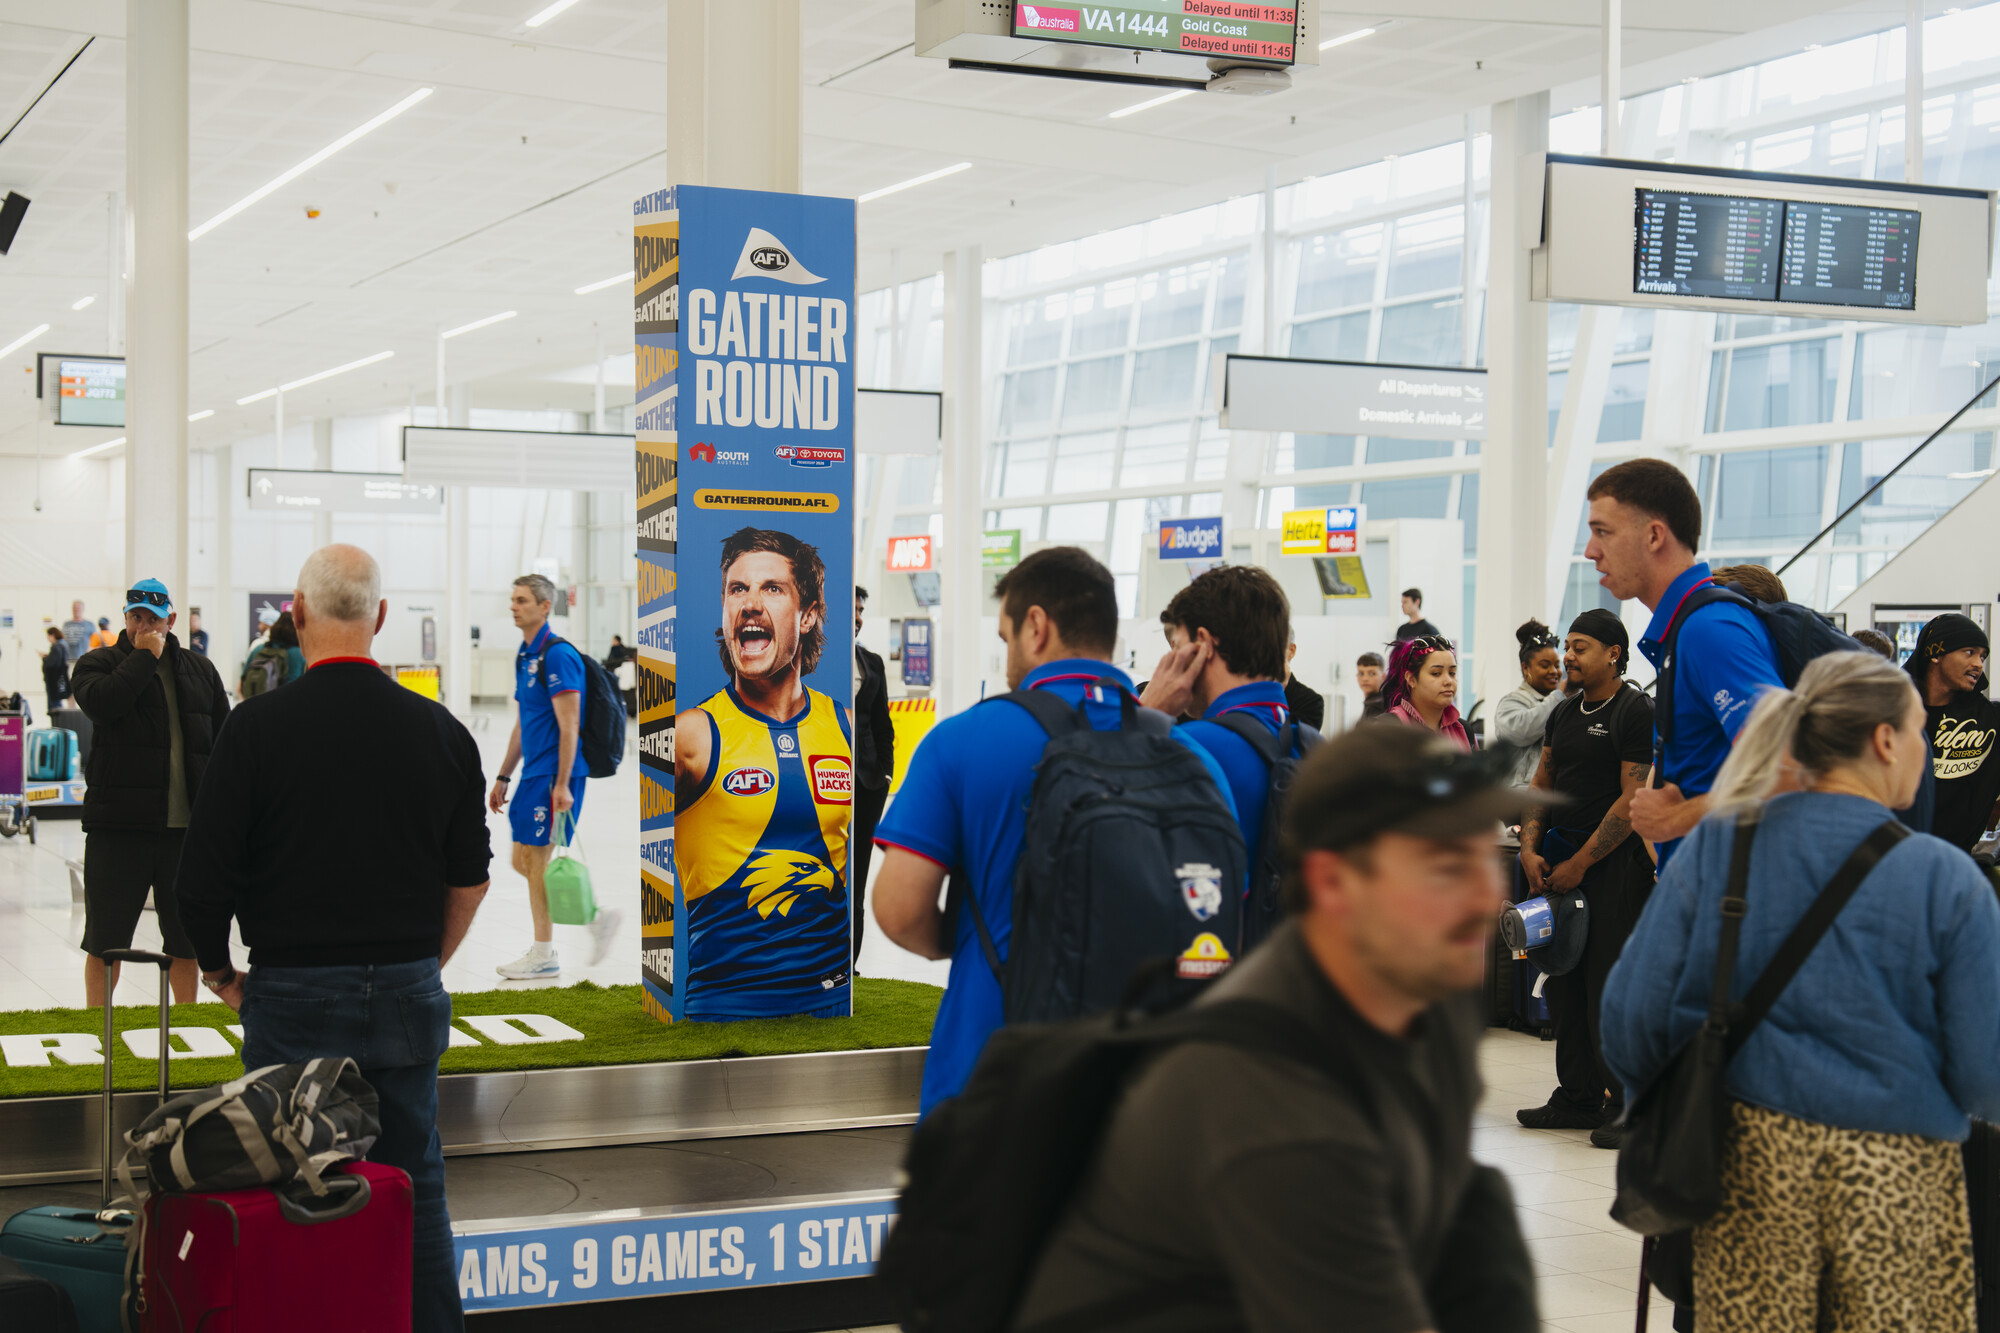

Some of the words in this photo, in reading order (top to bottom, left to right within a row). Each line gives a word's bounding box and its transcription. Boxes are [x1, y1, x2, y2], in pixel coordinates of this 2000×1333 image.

[1039, 17, 1074, 30] australia
[1082, 7, 1169, 38] VA1444
[1182, 19, 1210, 33] Gold
[1213, 22, 1248, 36] Coast
[1184, 1, 1232, 18] Delayed
[1234, 5, 1260, 19] until
[1263, 9, 1294, 23] 11:35
[1181, 35, 1230, 53] Delayed
[1232, 40, 1258, 55] until
[1260, 44, 1291, 58] 11:45
[634, 235, 678, 285] ROUND
[753, 249, 787, 267] AFL
[1638, 278, 1677, 293] Arrivals
[635, 284, 679, 323] GATHER
[688, 288, 848, 363] GATHER
[635, 343, 679, 394] ROUND
[695, 359, 840, 430] ROUND
[1379, 379, 1396, 394] All
[1398, 380, 1462, 398] Departures
[635, 396, 678, 431] GATHER
[1359, 407, 1415, 424] Domestic
[1416, 411, 1462, 426] Arrivals
[717, 451, 749, 462] SOUTH
[776, 447, 796, 458] AFL
[812, 450, 843, 459] TOYOTA
[636, 450, 677, 500] ROUND
[704, 494, 829, 508] GATHERROUND.AFL
[637, 505, 678, 542] GATHER
[1285, 519, 1322, 540] Hertz
[891, 537, 927, 568] AVIS
[1175, 527, 1220, 554] Budget
[637, 557, 677, 609] ROUND
[637, 617, 676, 653] GATHER
[638, 663, 676, 714] ROUND
[639, 727, 676, 764] GATHER
[1949, 748, 1983, 758] ASTERISKS
[817, 771, 850, 780] HUNGRY
[1943, 760, 1979, 775] LOOKS
[640, 771, 675, 821] ROUND
[726, 774, 772, 793] AFL
[640, 838, 675, 874] GATHER
[641, 877, 674, 927] ROUND
[642, 947, 674, 985] GATHER
[458, 1242, 560, 1300] AMS,
[572, 1237, 598, 1289] 9
[611, 1225, 757, 1286] GAMES,
[769, 1222, 785, 1271] 1
